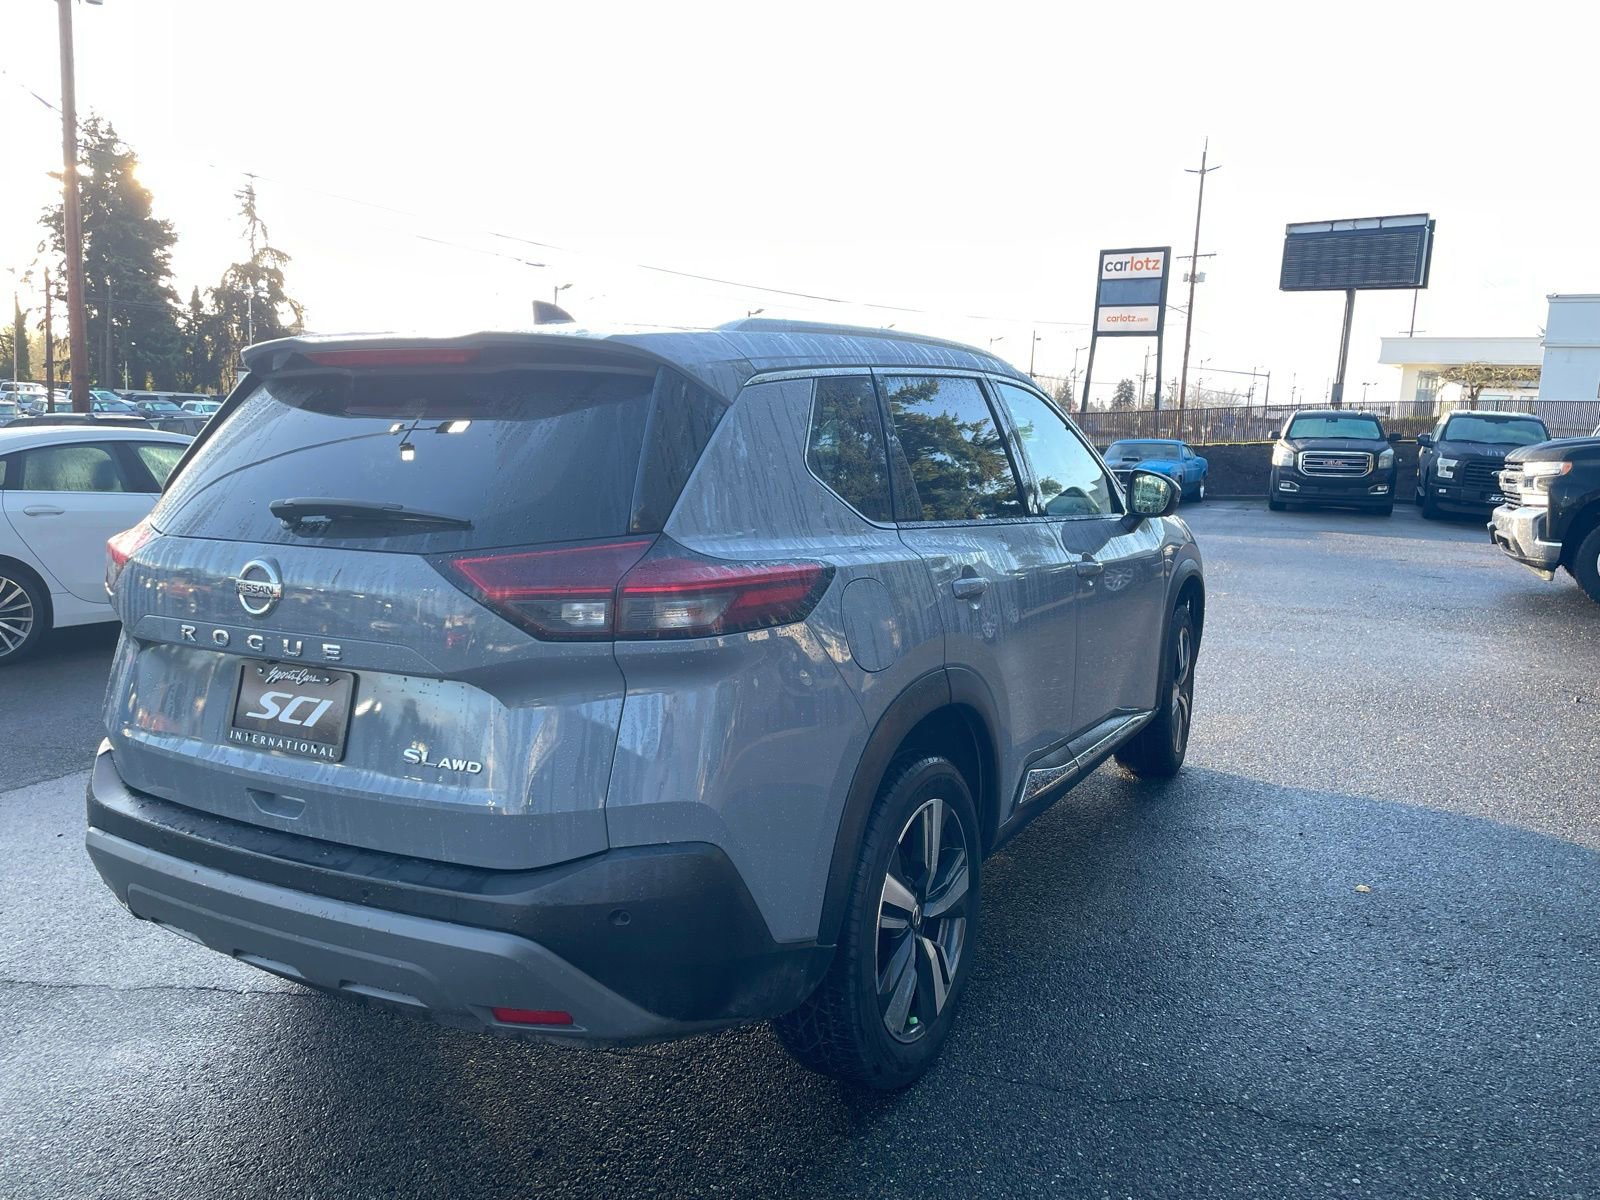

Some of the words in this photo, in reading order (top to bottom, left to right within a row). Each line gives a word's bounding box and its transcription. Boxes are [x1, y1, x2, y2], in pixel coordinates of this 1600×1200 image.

[1105, 256, 1160, 272] carlotz
[236, 582, 274, 595] NISSAN
[180, 624, 341, 661] ROGUE
[265, 666, 298, 683] Sports
[296, 668, 321, 685] Cars
[245, 690, 334, 728] SCI
[229, 730, 335, 758] INTERNATIONAL
